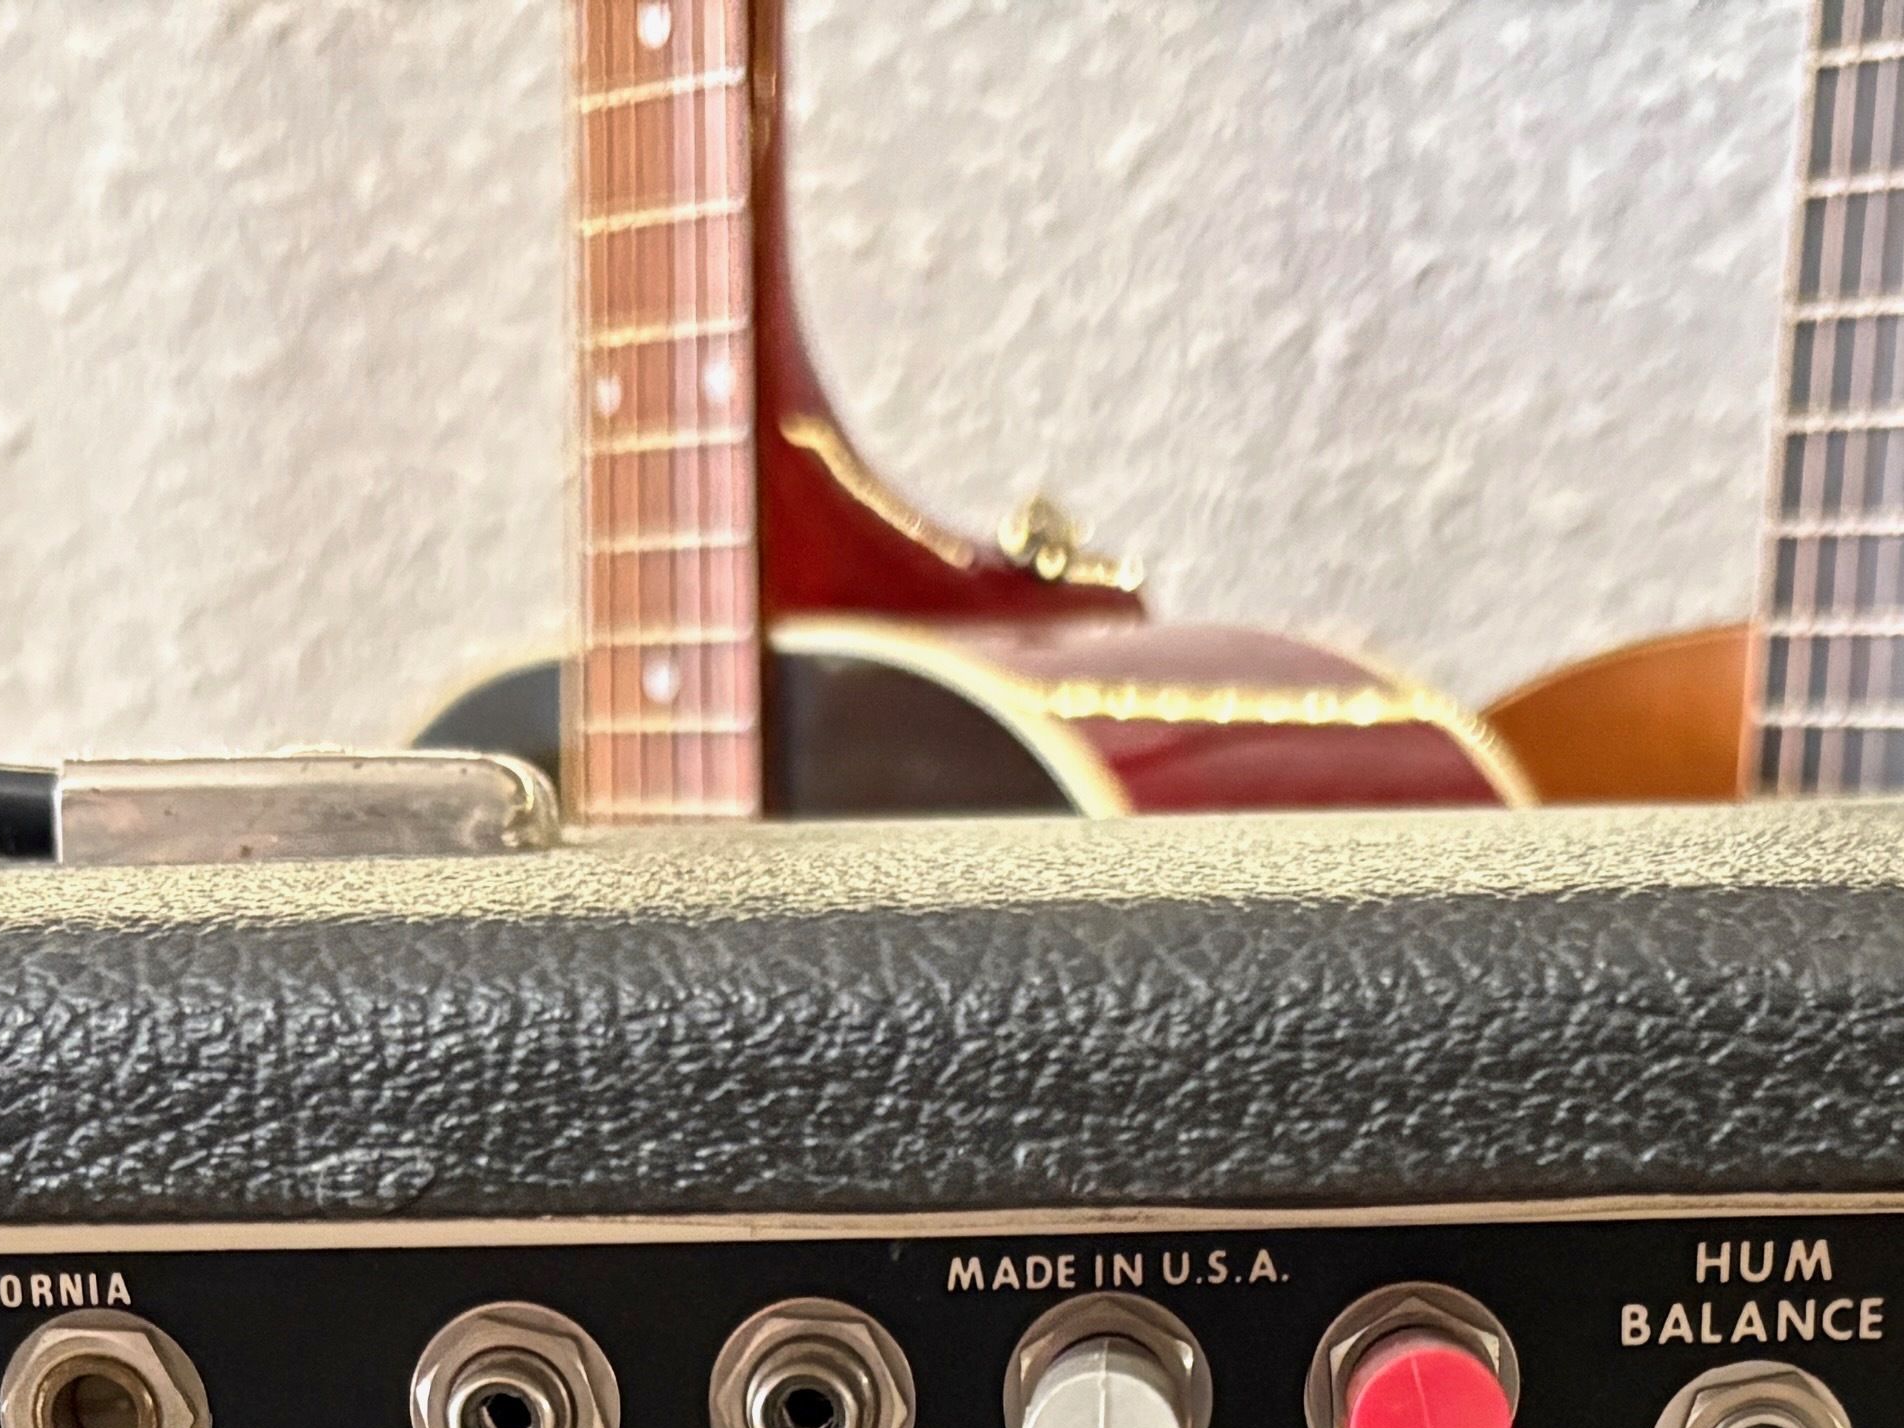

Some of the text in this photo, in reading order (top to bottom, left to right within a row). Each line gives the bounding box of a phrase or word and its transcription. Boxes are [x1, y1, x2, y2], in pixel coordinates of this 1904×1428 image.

[948, 1249, 1288, 1291] MADE IN U.S.A.
[1697, 1239, 1832, 1283] HUM
[1622, 1298, 1883, 1345] BALANCE
